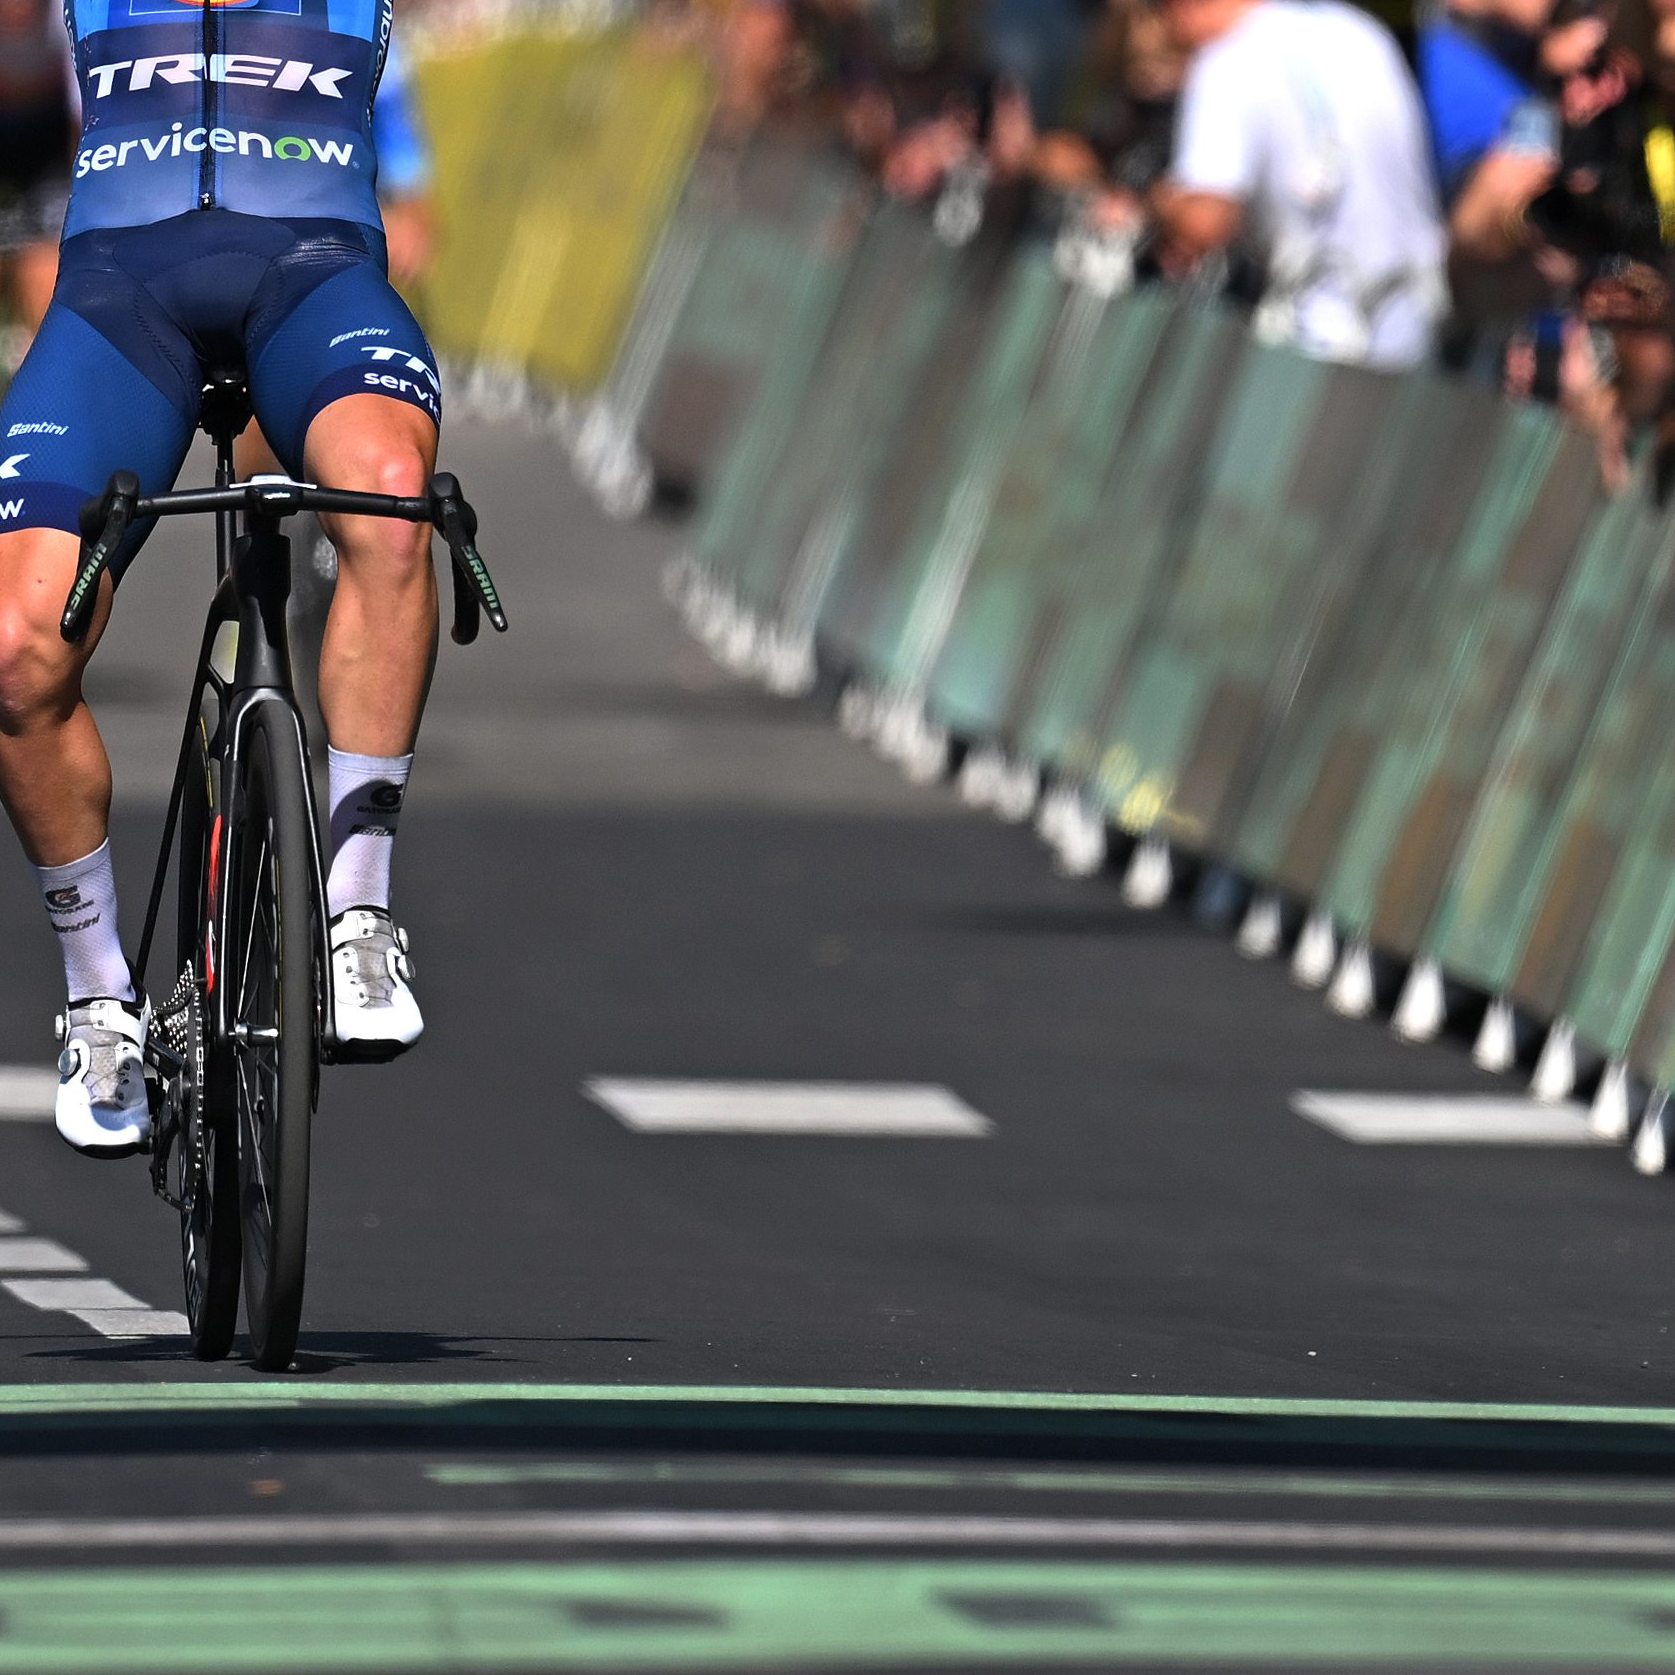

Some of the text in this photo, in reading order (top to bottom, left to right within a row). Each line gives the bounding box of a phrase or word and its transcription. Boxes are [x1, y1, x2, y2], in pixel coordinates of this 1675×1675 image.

[89, 53, 353, 99] TREK
[75, 122, 354, 179] servicenow
[329, 327, 390, 348] Santini
[6, 421, 69, 437] Santini
